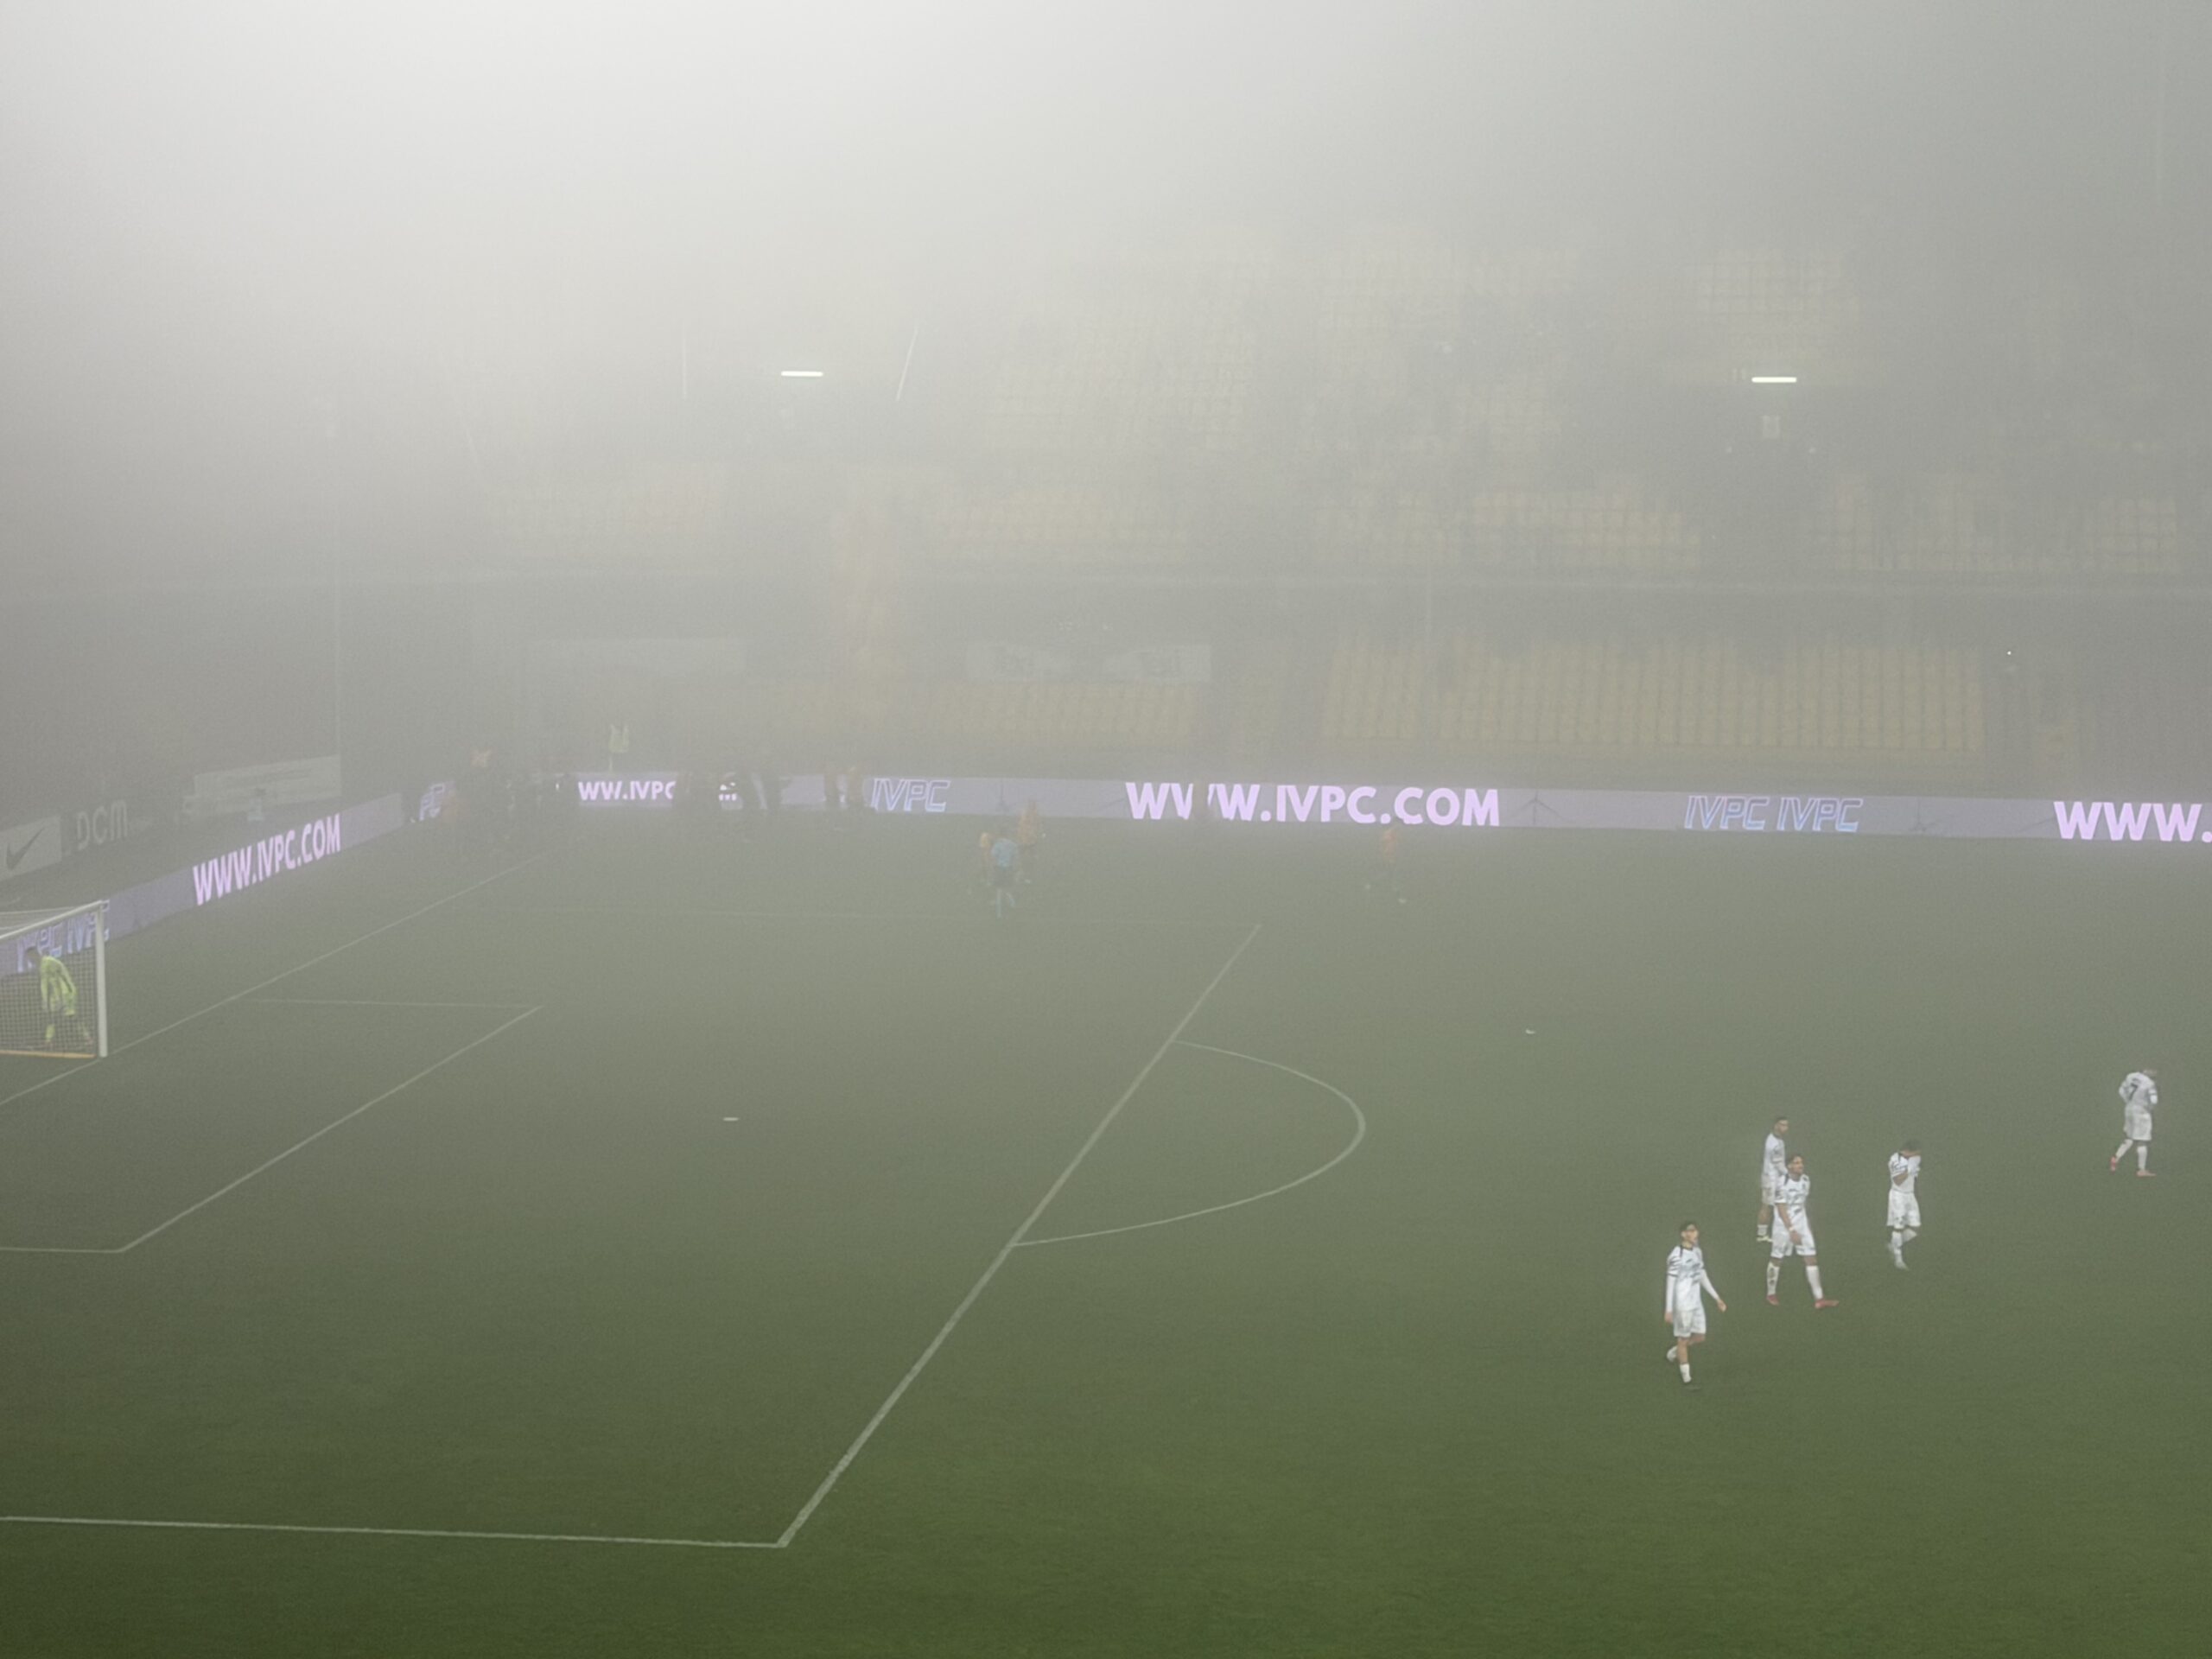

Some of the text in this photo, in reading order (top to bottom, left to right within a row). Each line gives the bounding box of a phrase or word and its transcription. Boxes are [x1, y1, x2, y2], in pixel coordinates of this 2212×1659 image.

[871, 779, 950, 812] IVPC
[1685, 795, 1864, 833] IVPC IVPC
[2053, 801, 2212, 843] WWW.
[192, 812, 341, 906] WWW.IVPC.COM
[2130, 1083, 2139, 1101] 7
